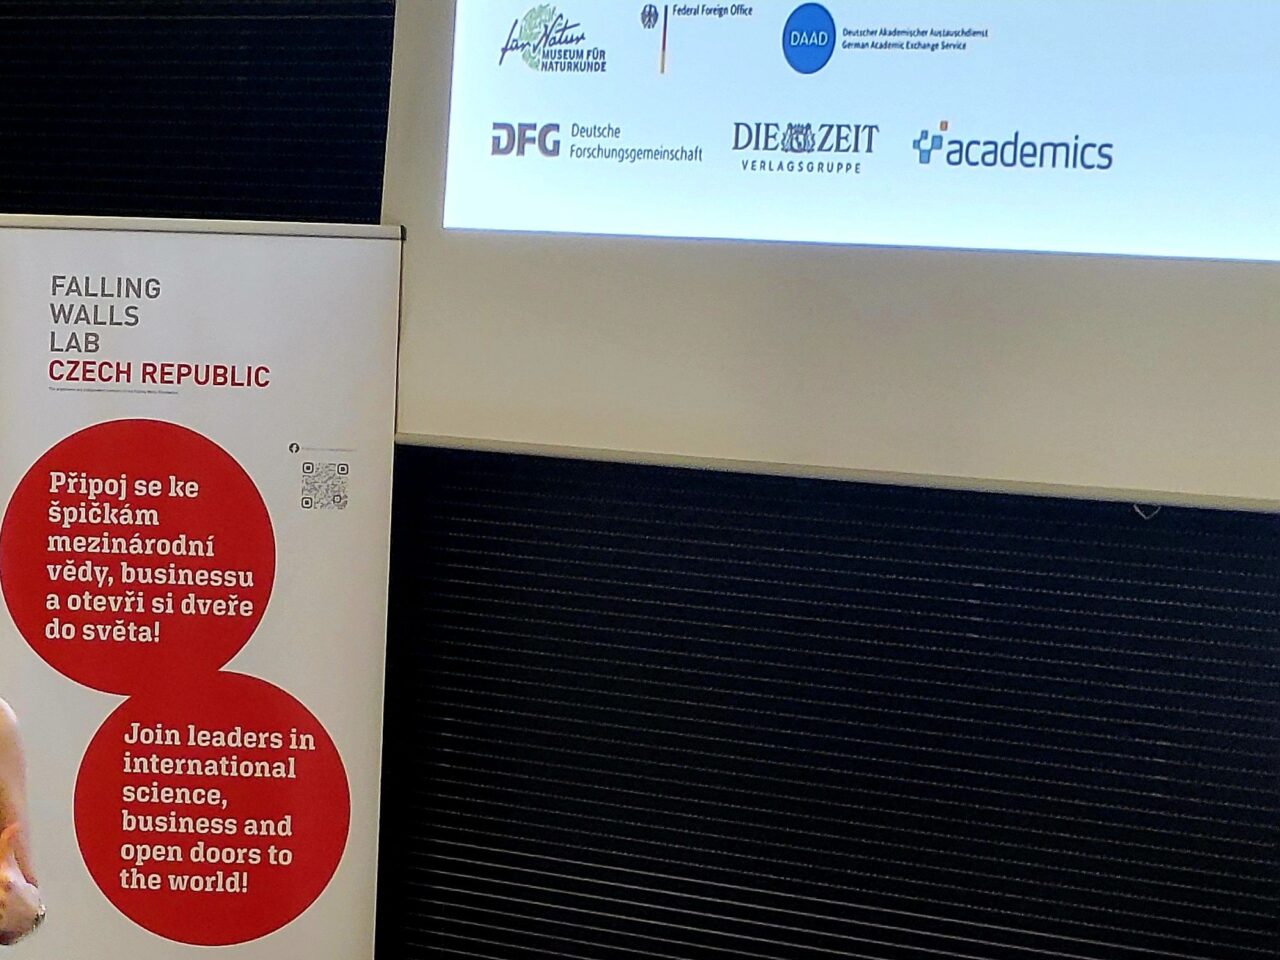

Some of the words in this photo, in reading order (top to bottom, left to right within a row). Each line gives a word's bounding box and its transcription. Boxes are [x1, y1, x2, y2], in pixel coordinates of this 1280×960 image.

[672, 4, 699, 16] Federal
[701, 4, 727, 18] Foreign
[730, 4, 753, 16] Office
[790, 31, 828, 46] DAAD
[842, 28, 878, 37] Deutscher
[879, 28, 929, 38] Akademischer
[541, 49, 583, 60] MUSEUM
[586, 47, 606, 61] FÜR
[842, 41, 869, 50] German
[870, 41, 904, 50] Academic
[906, 41, 939, 51] Exchange
[941, 41, 967, 50] Service
[540, 61, 607, 72] NATURKUNDE
[491, 122, 560, 157] DFG
[571, 123, 621, 139] Deutsche
[732, 122, 780, 153] DIE
[819, 123, 880, 154] ZEIT
[570, 144, 703, 163] Forschungsgemeinschaft
[946, 131, 1113, 170] academics
[741, 159, 861, 174] VERLAGSGRUPPE
[51, 275, 162, 299] FALLING
[50, 303, 140, 327] WALLS
[50, 332, 100, 353] LAB
[48, 359, 132, 384] CZECH
[141, 362, 271, 388] REPUBLIC
[49, 472, 128, 501] Připoj
[134, 479, 162, 498] se
[168, 476, 199, 498] ke
[48, 502, 160, 527] špičkám
[47, 533, 215, 557] mezinárodní
[46, 560, 115, 588] vědy,
[121, 562, 254, 588] businessu
[46, 594, 61, 611] a
[67, 590, 145, 614] otevři
[152, 593, 174, 614] si
[181, 594, 254, 617] dveře
[45, 619, 76, 640] do
[82, 621, 161, 643] světa!
[124, 722, 181, 746] Join
[187, 725, 283, 749] leaders
[289, 728, 316, 751] in
[122, 753, 297, 779] international
[122, 782, 228, 809] science,
[121, 810, 237, 836] business
[244, 815, 293, 837] and
[120, 843, 183, 866] open
[190, 842, 261, 864] doors
[267, 845, 293, 866] to
[119, 869, 161, 890] the
[168, 872, 248, 893] world!
